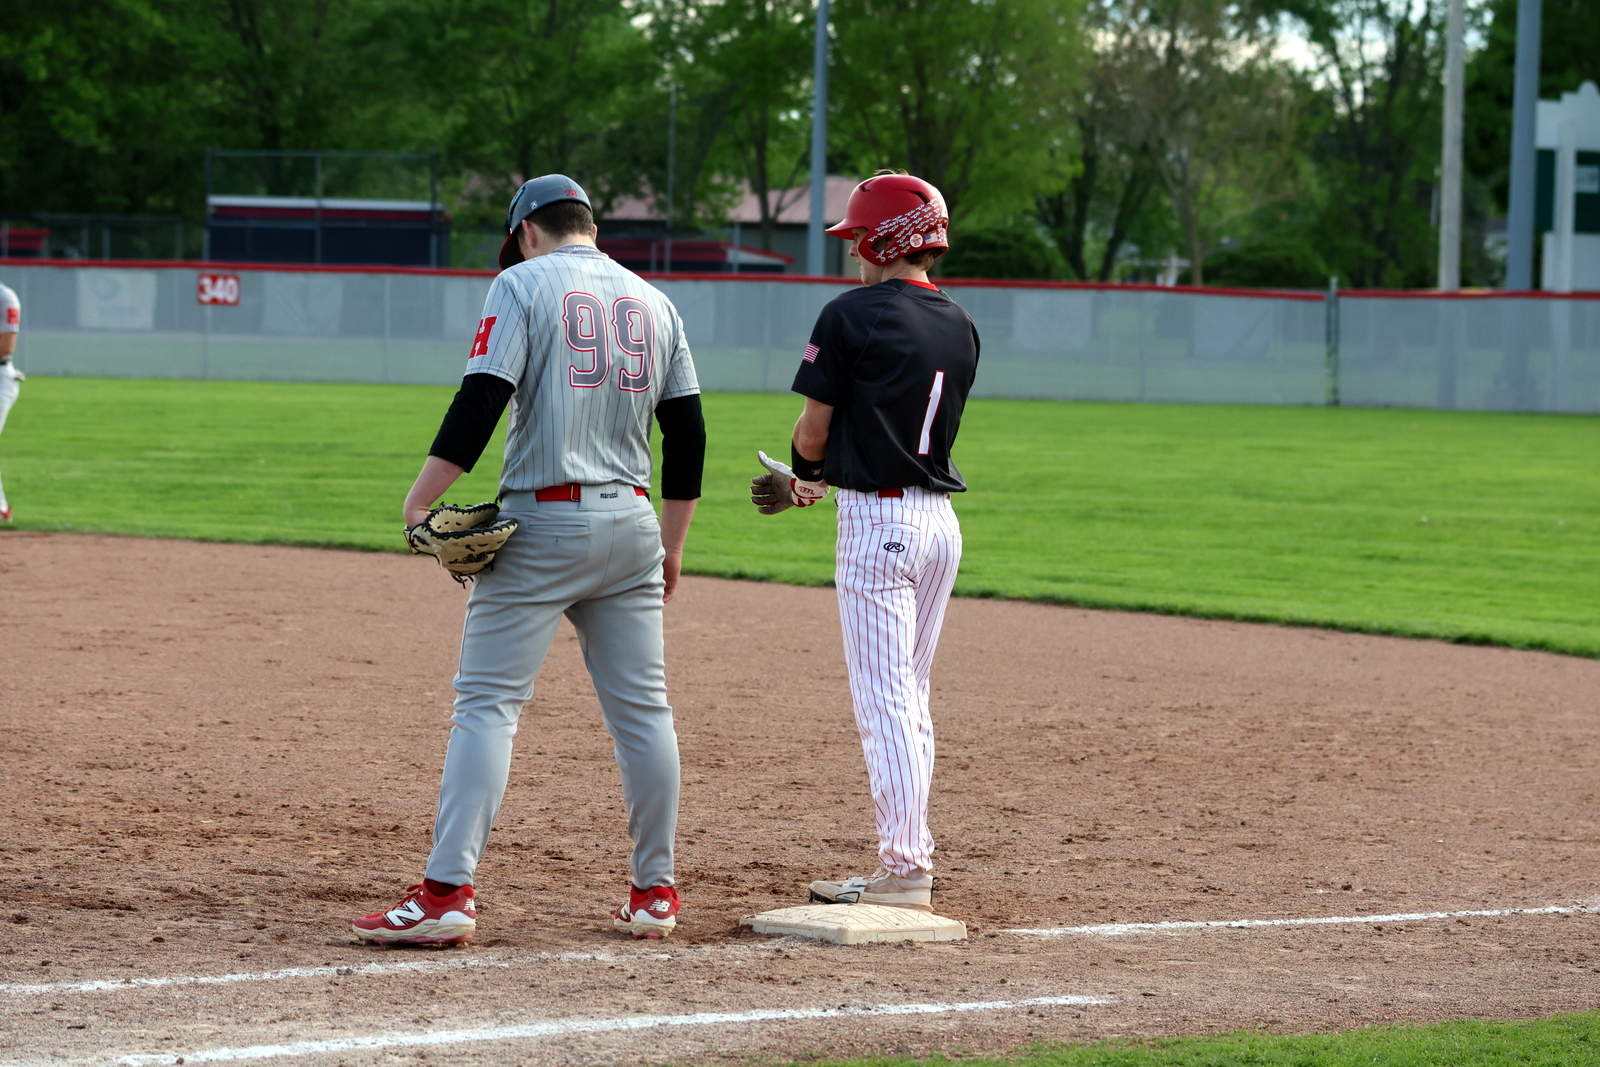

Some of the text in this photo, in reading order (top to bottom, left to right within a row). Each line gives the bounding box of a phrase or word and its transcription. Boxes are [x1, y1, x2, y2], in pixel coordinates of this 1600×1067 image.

[200, 277, 238, 302] 340
[469, 316, 498, 359] H
[562, 291, 655, 392] 99
[917, 369, 945, 456] 1
